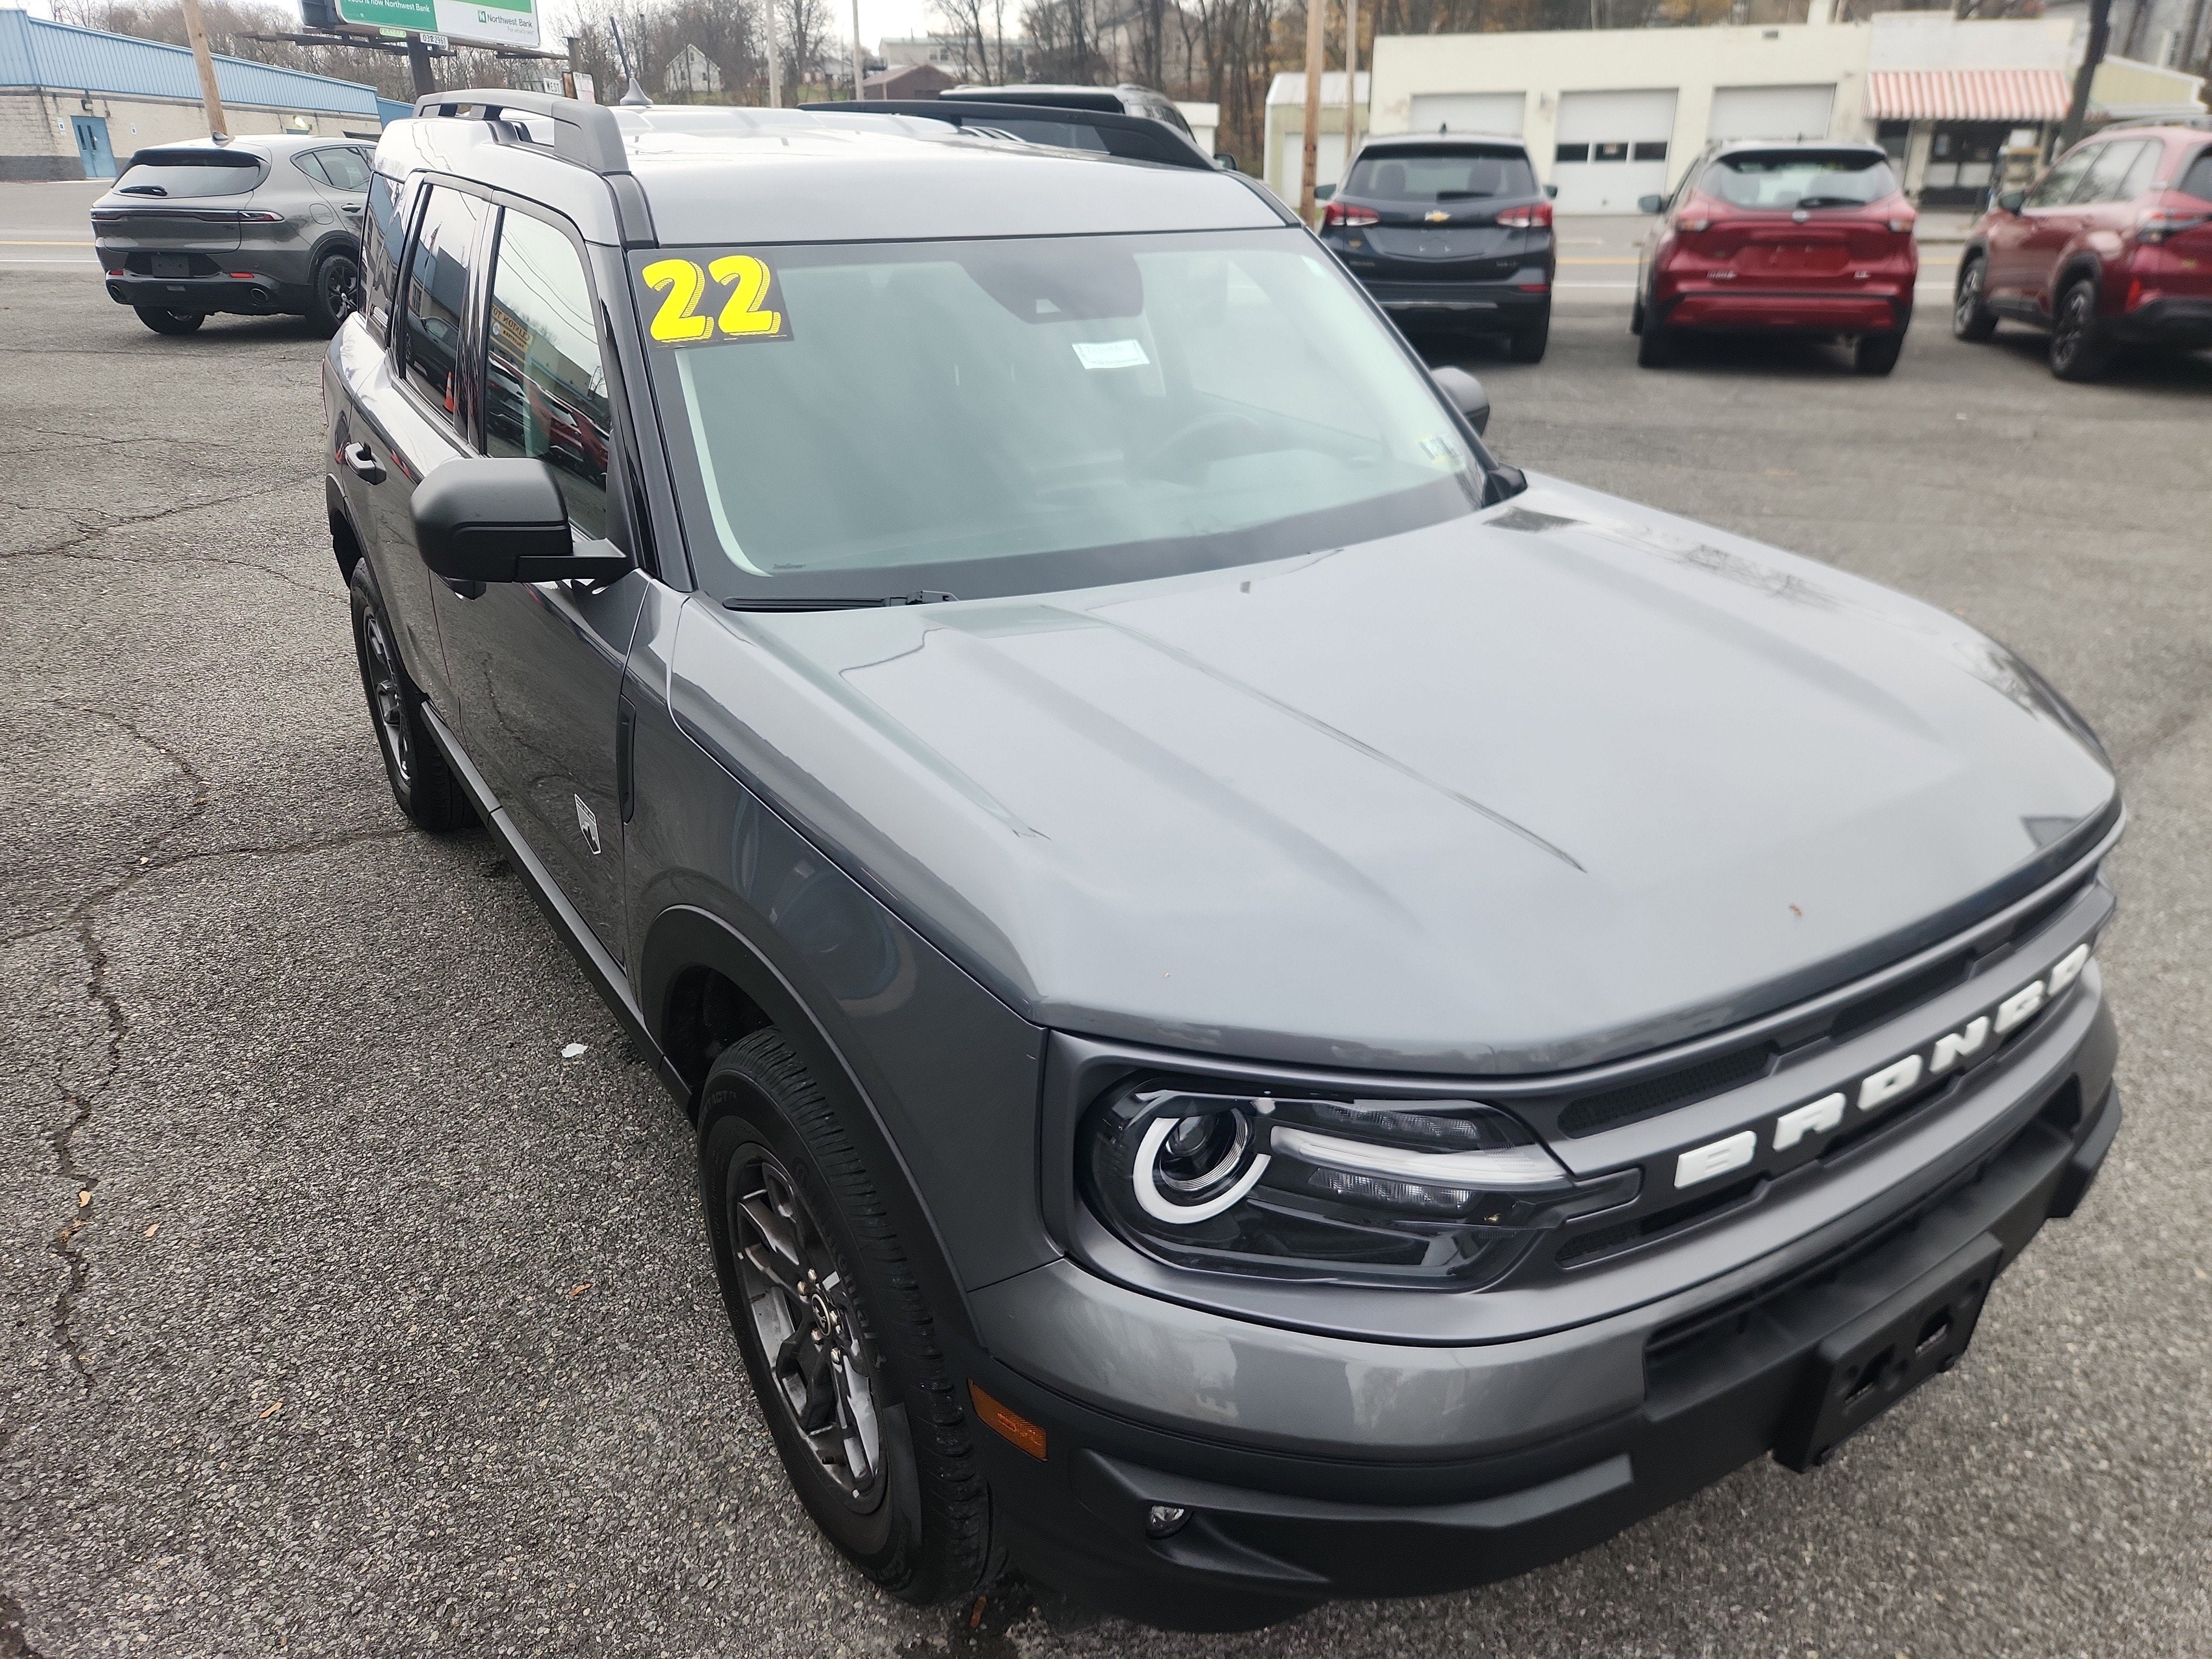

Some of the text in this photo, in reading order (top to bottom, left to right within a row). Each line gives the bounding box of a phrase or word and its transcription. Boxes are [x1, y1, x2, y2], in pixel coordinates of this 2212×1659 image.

[384, 0, 415, 10] Northwest
[416, 4, 430, 12] Bank
[487, 14, 533, 28] Northwest Bank
[545, 80, 560, 93] WEST
[642, 255, 781, 344] 22
[1674, 943, 2089, 1188] BRONCO
